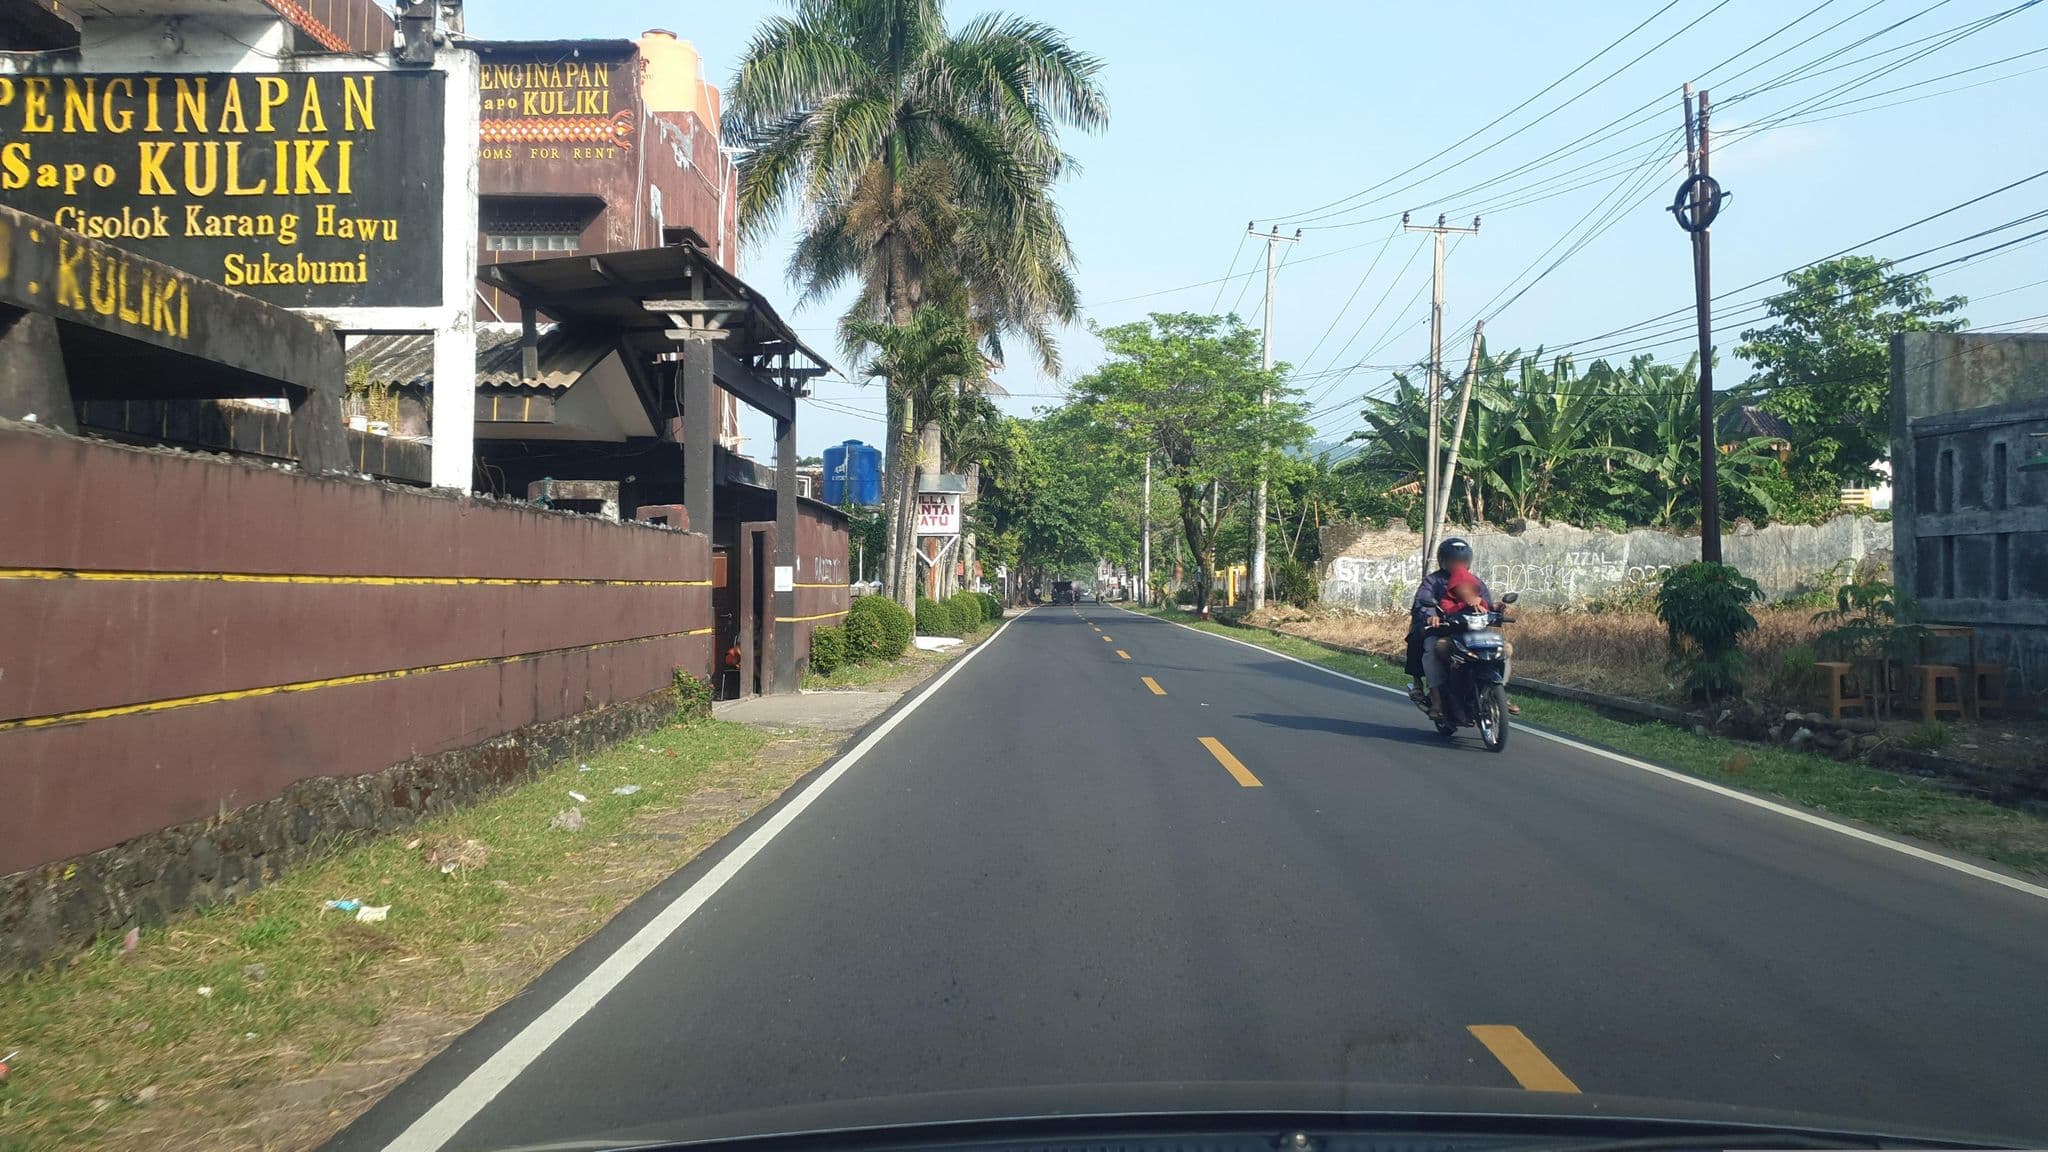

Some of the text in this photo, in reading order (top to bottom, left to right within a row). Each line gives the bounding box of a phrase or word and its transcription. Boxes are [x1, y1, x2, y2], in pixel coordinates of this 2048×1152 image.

[480, 62, 609, 90] ENGINAPAN
[480, 90, 609, 115] apo KULIKI
[479, 148, 615, 159] OMS FOR RENT
[2, 140, 354, 197] Sapo KULIKI
[55, 204, 398, 245] Cisolok Karang Hawu
[224, 252, 368, 286] Sukabumi
[57, 237, 189, 339] KULIKI
[918, 505, 954, 515] NTAI
[919, 495, 947, 504] ILLA
[920, 515, 948, 526] ATU
